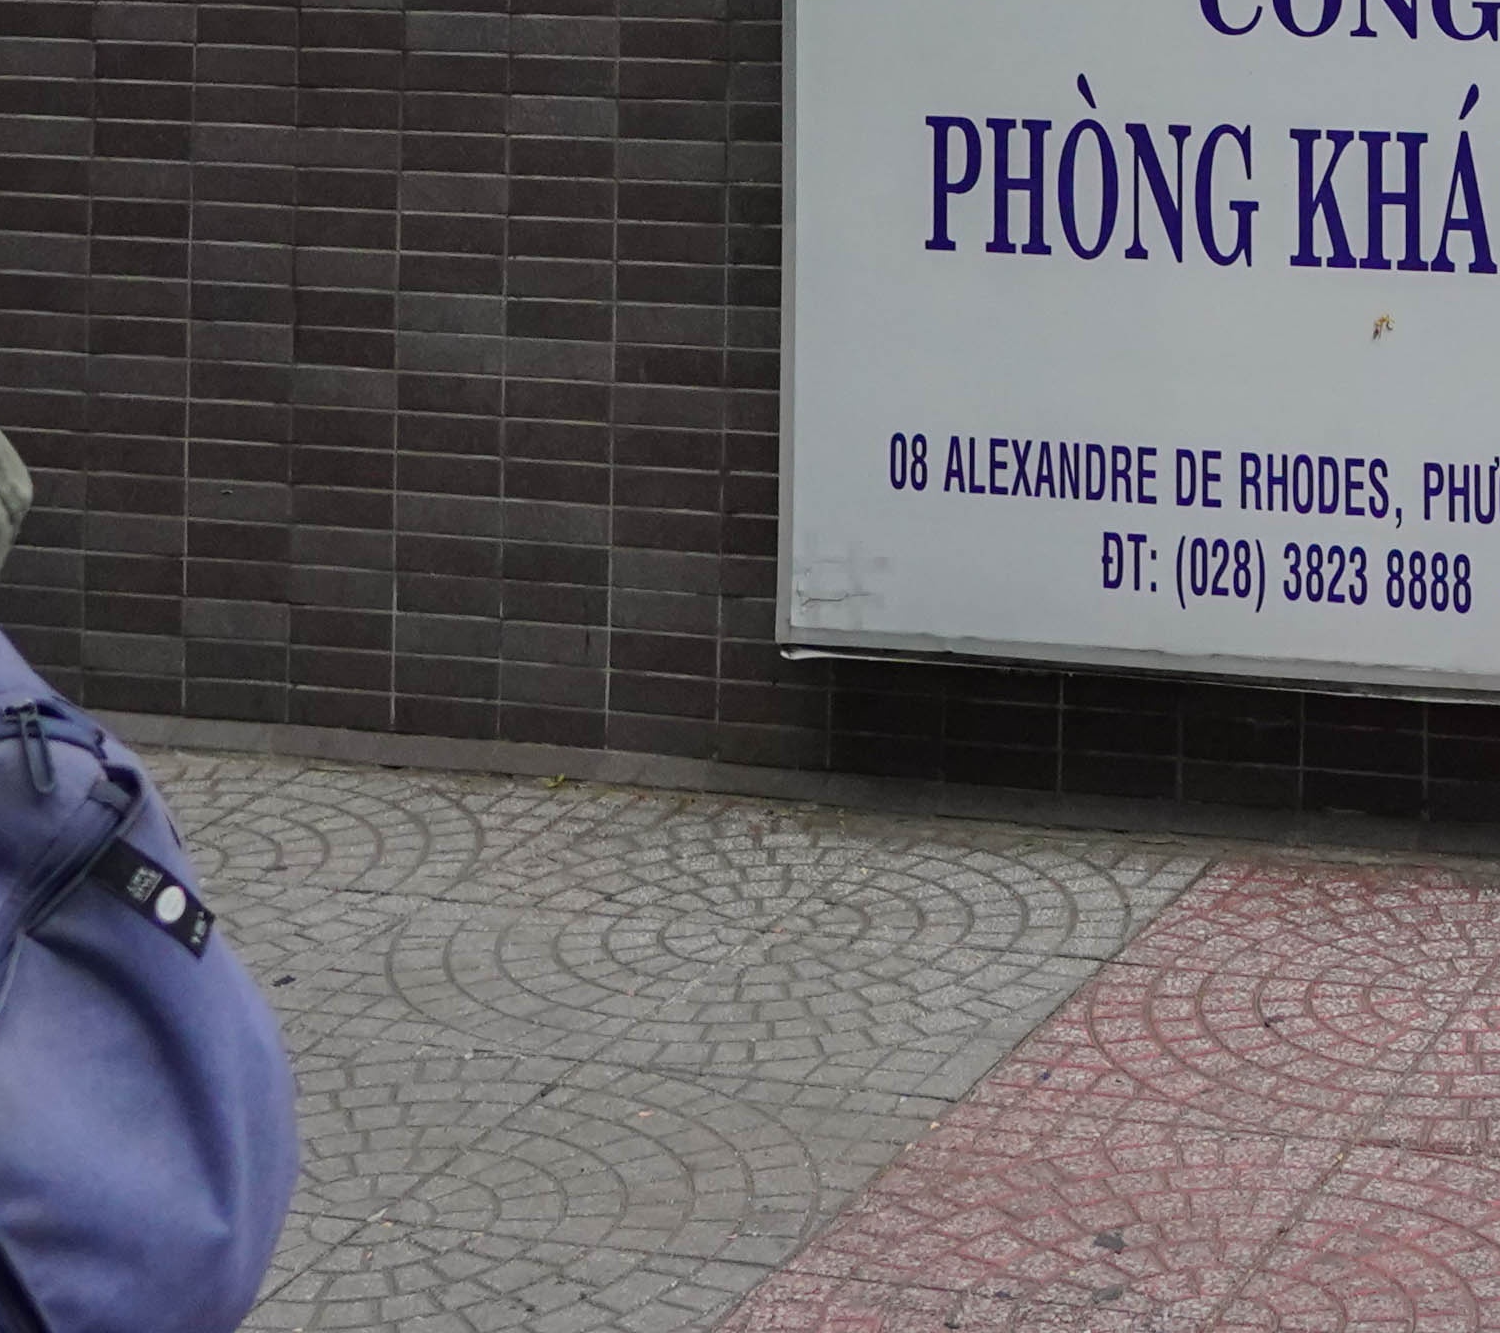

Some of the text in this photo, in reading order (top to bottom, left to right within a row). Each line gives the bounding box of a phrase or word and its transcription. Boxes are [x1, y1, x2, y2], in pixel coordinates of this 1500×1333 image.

[924, 73, 1260, 268] PHÒNG
[890, 432, 928, 492] 08
[943, 435, 1158, 505] ALEXANDRE
[1175, 448, 1222, 509] DE
[1240, 451, 1402, 529] RHODES,
[1101, 531, 1157, 593] ĐT:
[1176, 535, 1266, 613] (028)
[1283, 542, 1368, 606] 3823
[1386, 548, 1472, 614] 8888
